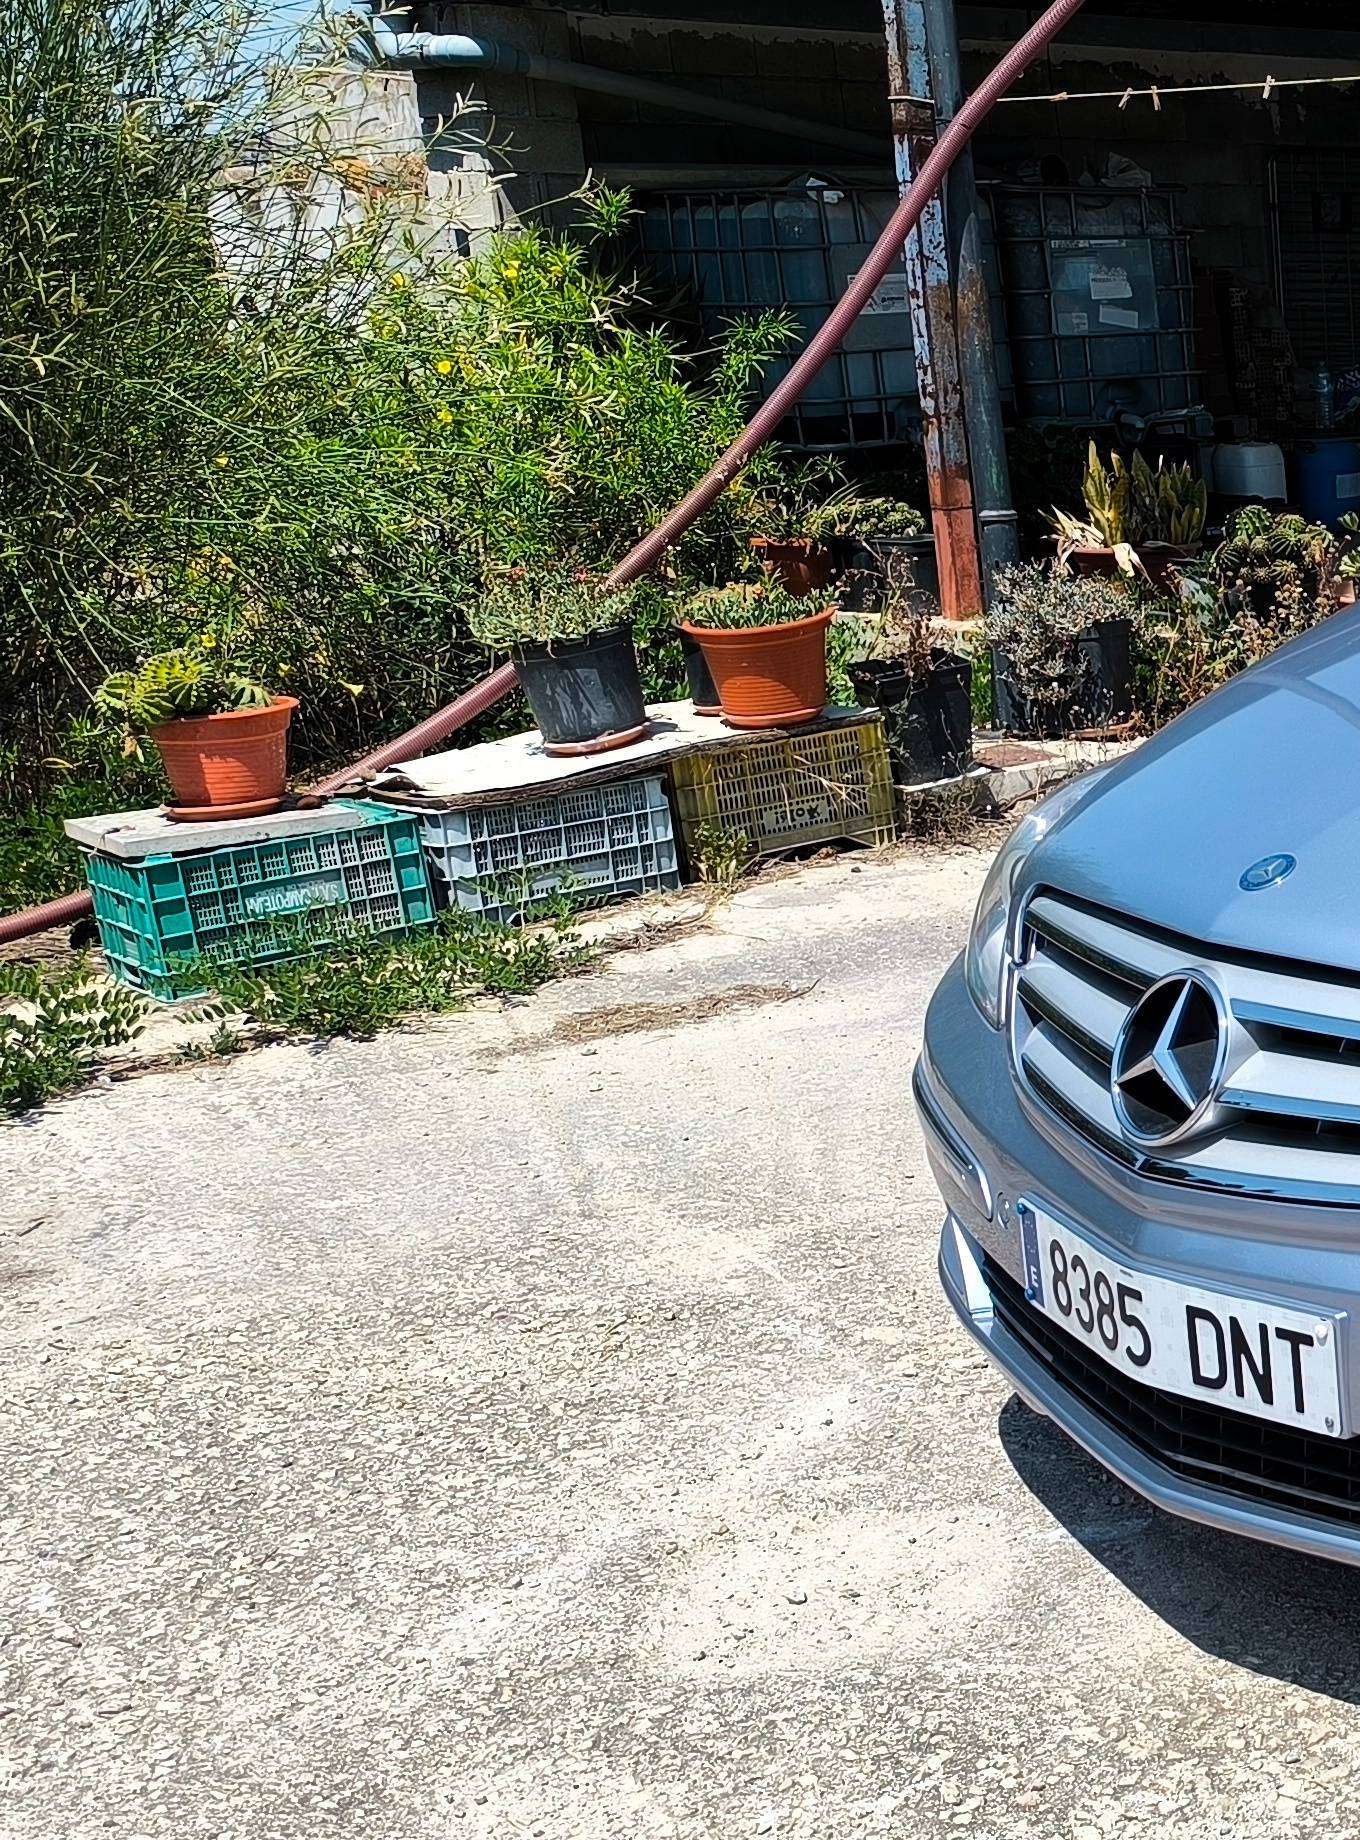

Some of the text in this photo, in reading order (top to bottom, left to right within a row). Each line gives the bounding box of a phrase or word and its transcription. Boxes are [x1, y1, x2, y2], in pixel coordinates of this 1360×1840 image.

[1030, 1264, 1039, 1288] E
[1049, 1238, 1314, 1414] 8385 DNT
